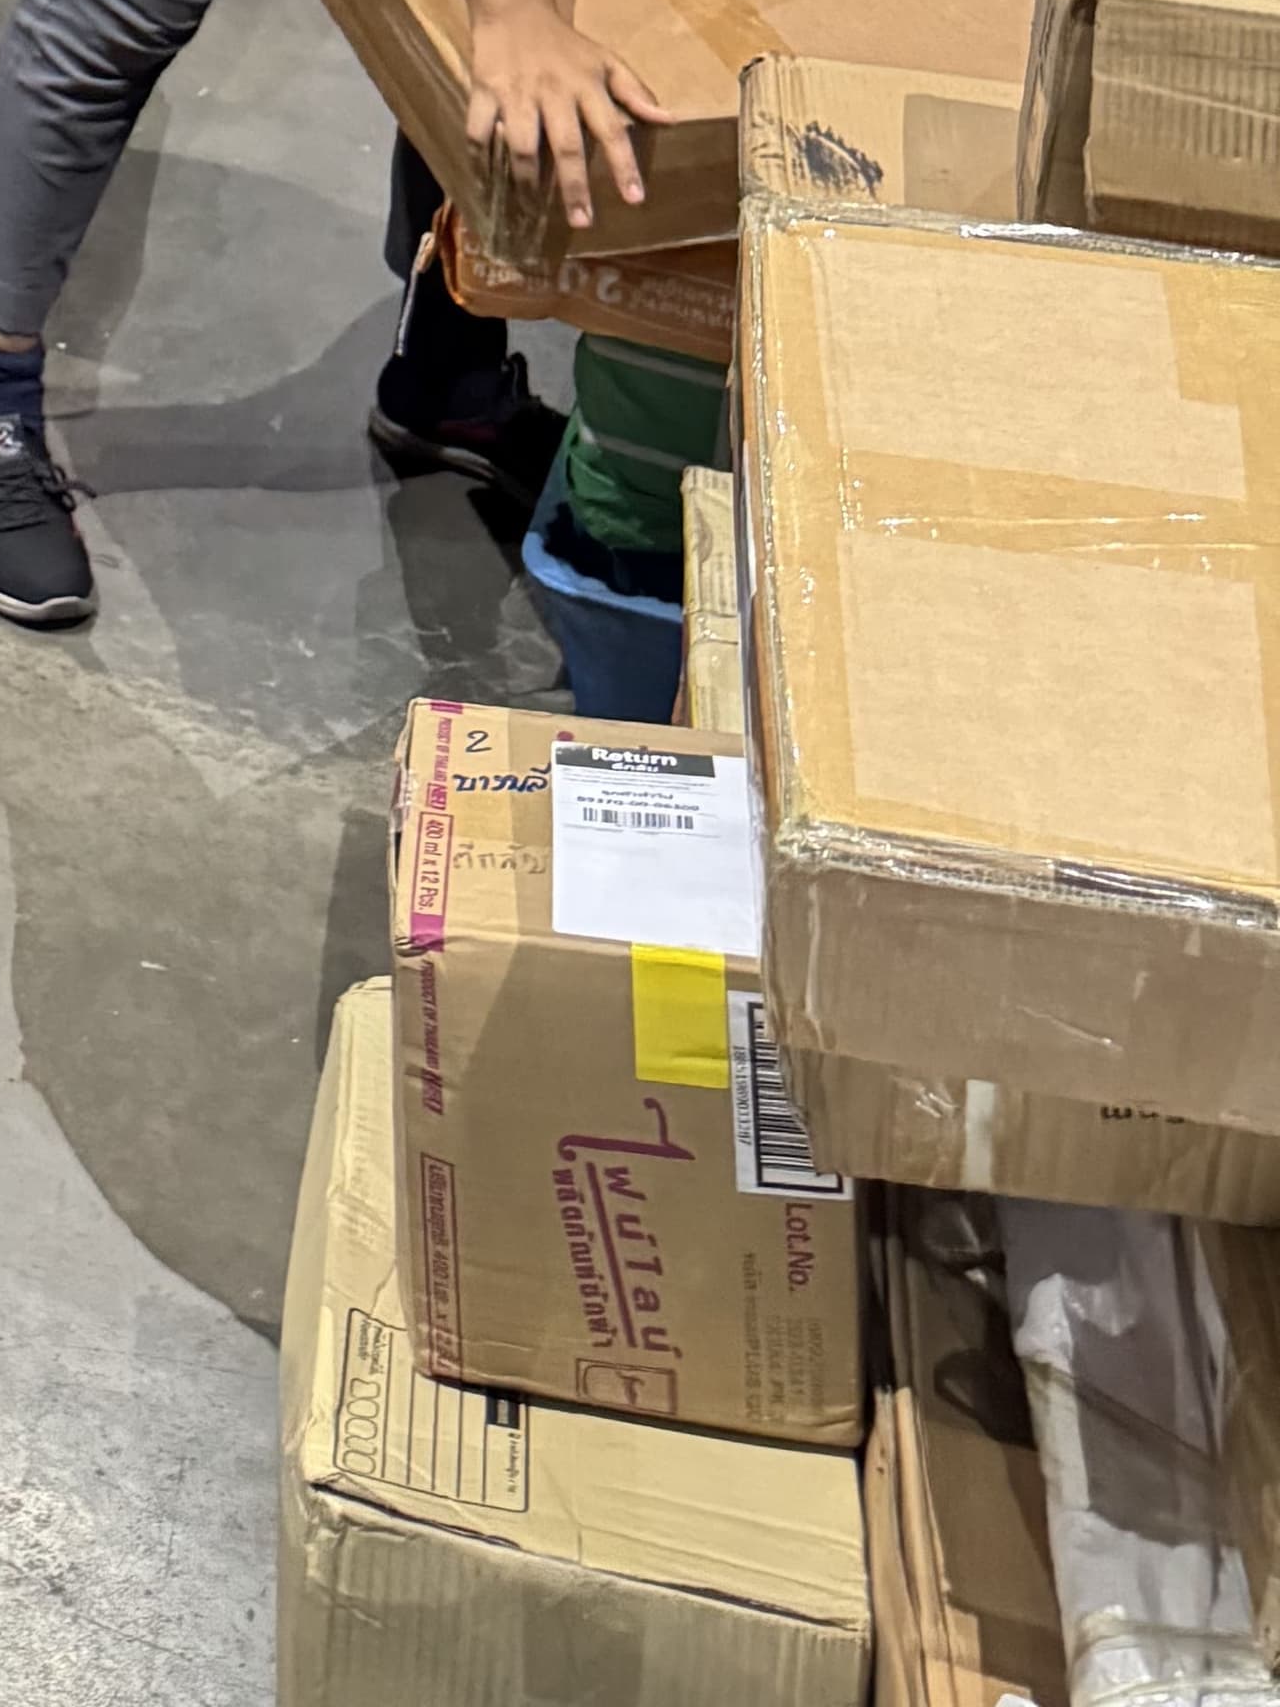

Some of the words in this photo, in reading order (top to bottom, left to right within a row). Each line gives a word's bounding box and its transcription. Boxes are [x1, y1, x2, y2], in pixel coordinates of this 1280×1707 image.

[465, 730, 493, 753] 2
[591, 747, 679, 767] Return
[424, 819, 442, 839] 400
[424, 841, 440, 857] ml
[420, 869, 439, 884] 12
[418, 886, 439, 912] Pcs.
[420, 960, 437, 1007] PRODUCT
[785, 1201, 815, 1294] Lot.No.
